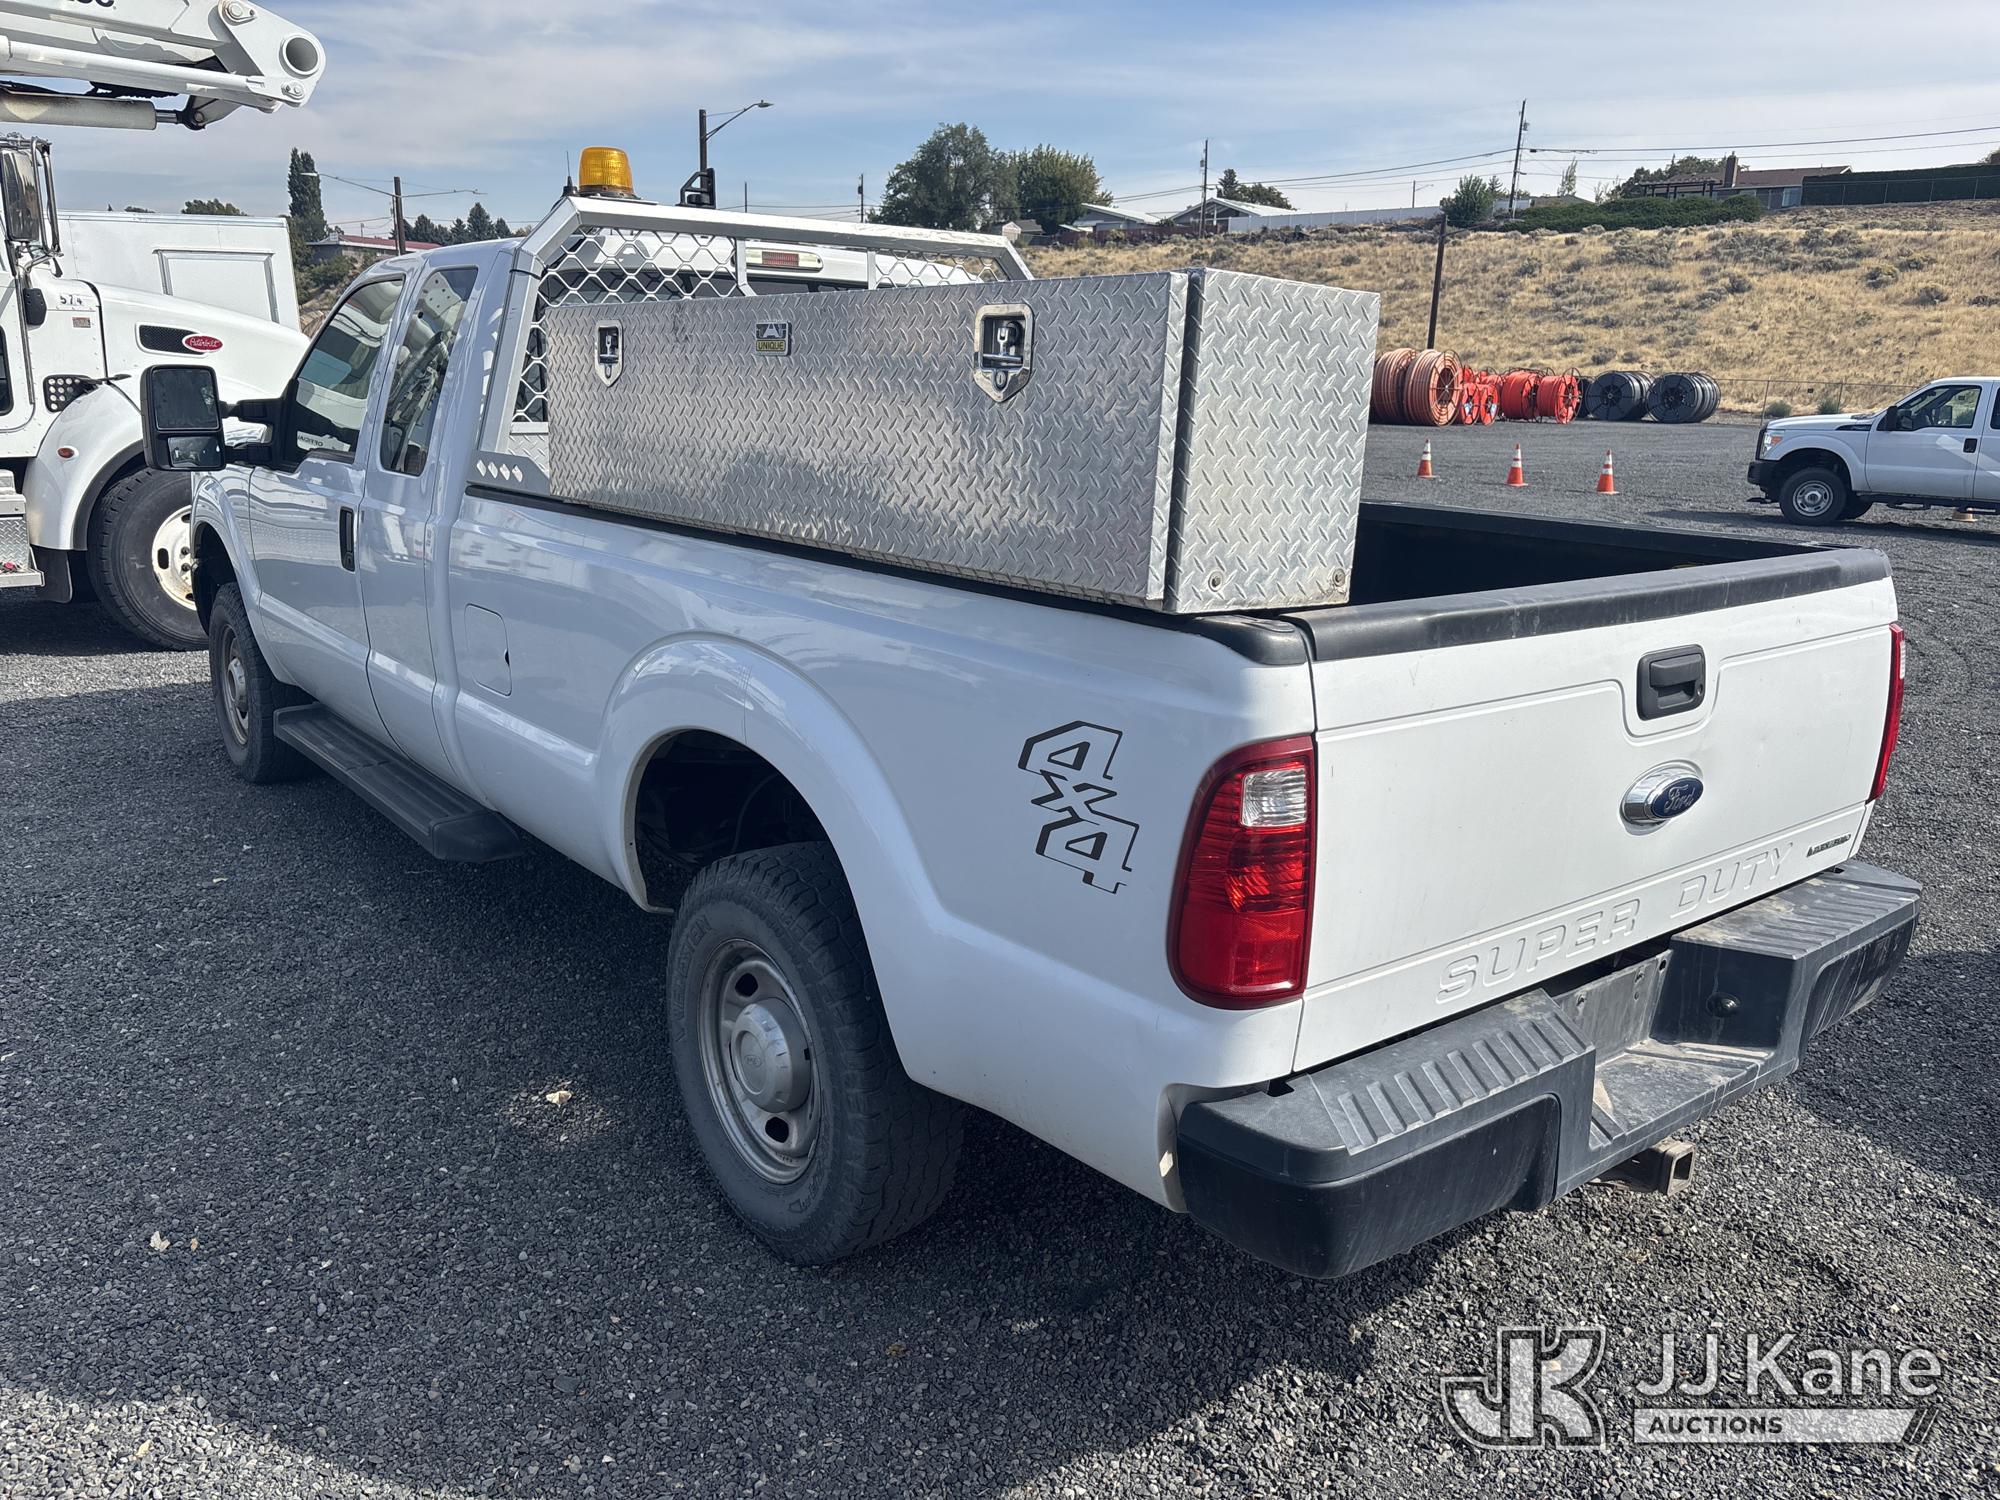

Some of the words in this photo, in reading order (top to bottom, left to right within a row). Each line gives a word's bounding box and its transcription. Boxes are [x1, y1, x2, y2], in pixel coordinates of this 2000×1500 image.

[758, 341, 784, 350] UNIQUE
[1663, 783, 1696, 813] Ford
[1436, 898, 1640, 1004] SUPER
[1670, 842, 1793, 919] DUTY
